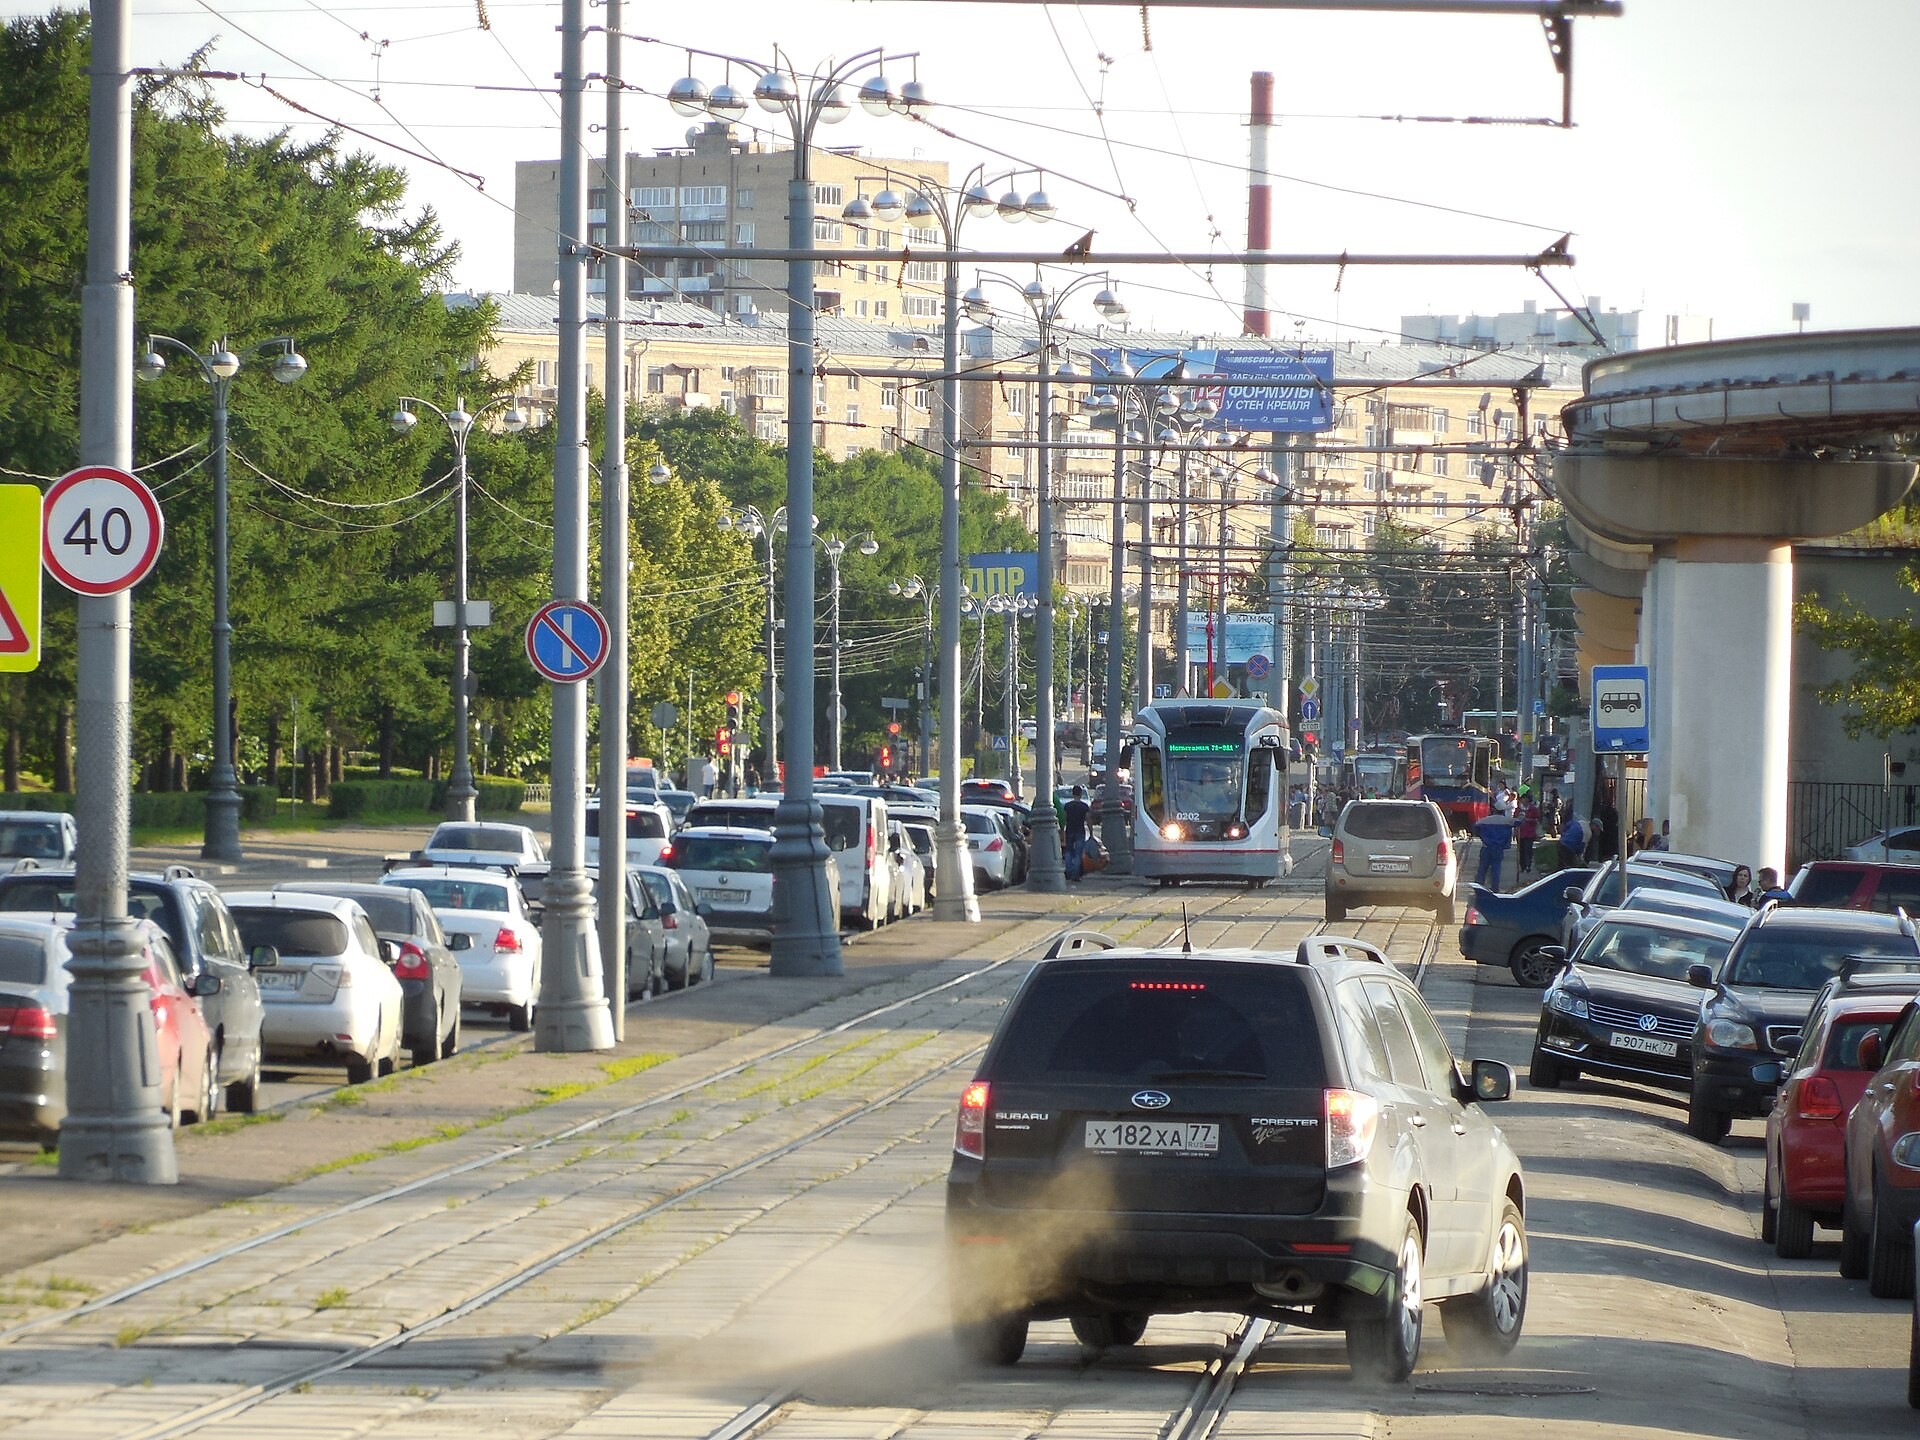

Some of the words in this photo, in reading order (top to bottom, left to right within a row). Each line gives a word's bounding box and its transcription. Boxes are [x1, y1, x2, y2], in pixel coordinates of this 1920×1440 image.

[1233, 356, 1275, 364] MOSCOW
[1296, 356, 1328, 364] ACING
[1228, 386, 1314, 399] ФОРМУЛЫ
[1226, 400, 1234, 410] У
[1236, 400, 1265, 410] СТЕН
[1266, 400, 1311, 410] КРЕМЛЯ
[63, 507, 132, 556] 40
[1176, 812, 1200, 821] 0202
[995, 1112, 1049, 1121] SUBARU
[1250, 1118, 1319, 1127] FORESTER
[1189, 1125, 1212, 1142] 77
[1187, 1141, 1205, 1149] RUS
